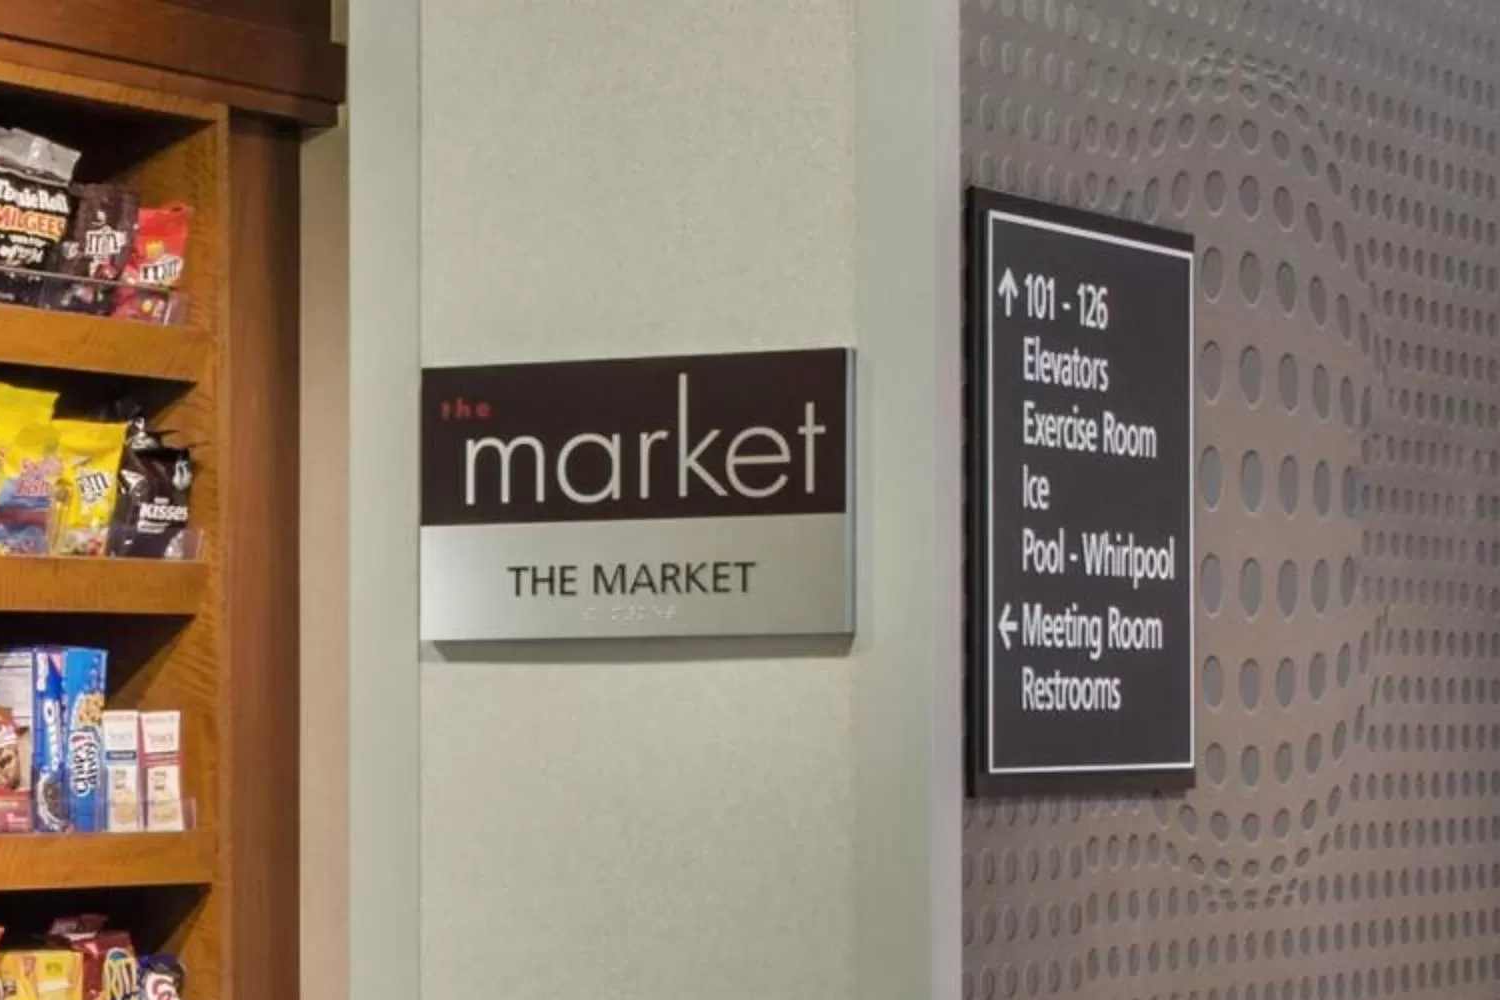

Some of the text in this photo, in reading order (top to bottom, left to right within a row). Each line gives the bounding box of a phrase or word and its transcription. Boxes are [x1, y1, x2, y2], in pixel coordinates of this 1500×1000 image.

[1024, 273, 1055, 320] 101
[1077, 283, 1108, 329] 126
[1023, 336, 1109, 392] Elevators
[440, 398, 492, 419] the
[1023, 400, 1157, 458] Exercise Room
[465, 372, 827, 505] market
[1022, 464, 1050, 510] Ice
[507, 561, 757, 597] THE MARKET
[1022, 527, 1065, 574] Pool
[1081, 530, 1175, 590] Whirlpool
[1022, 602, 1163, 660] Meeting Room
[1021, 666, 1122, 710] Restrooms
